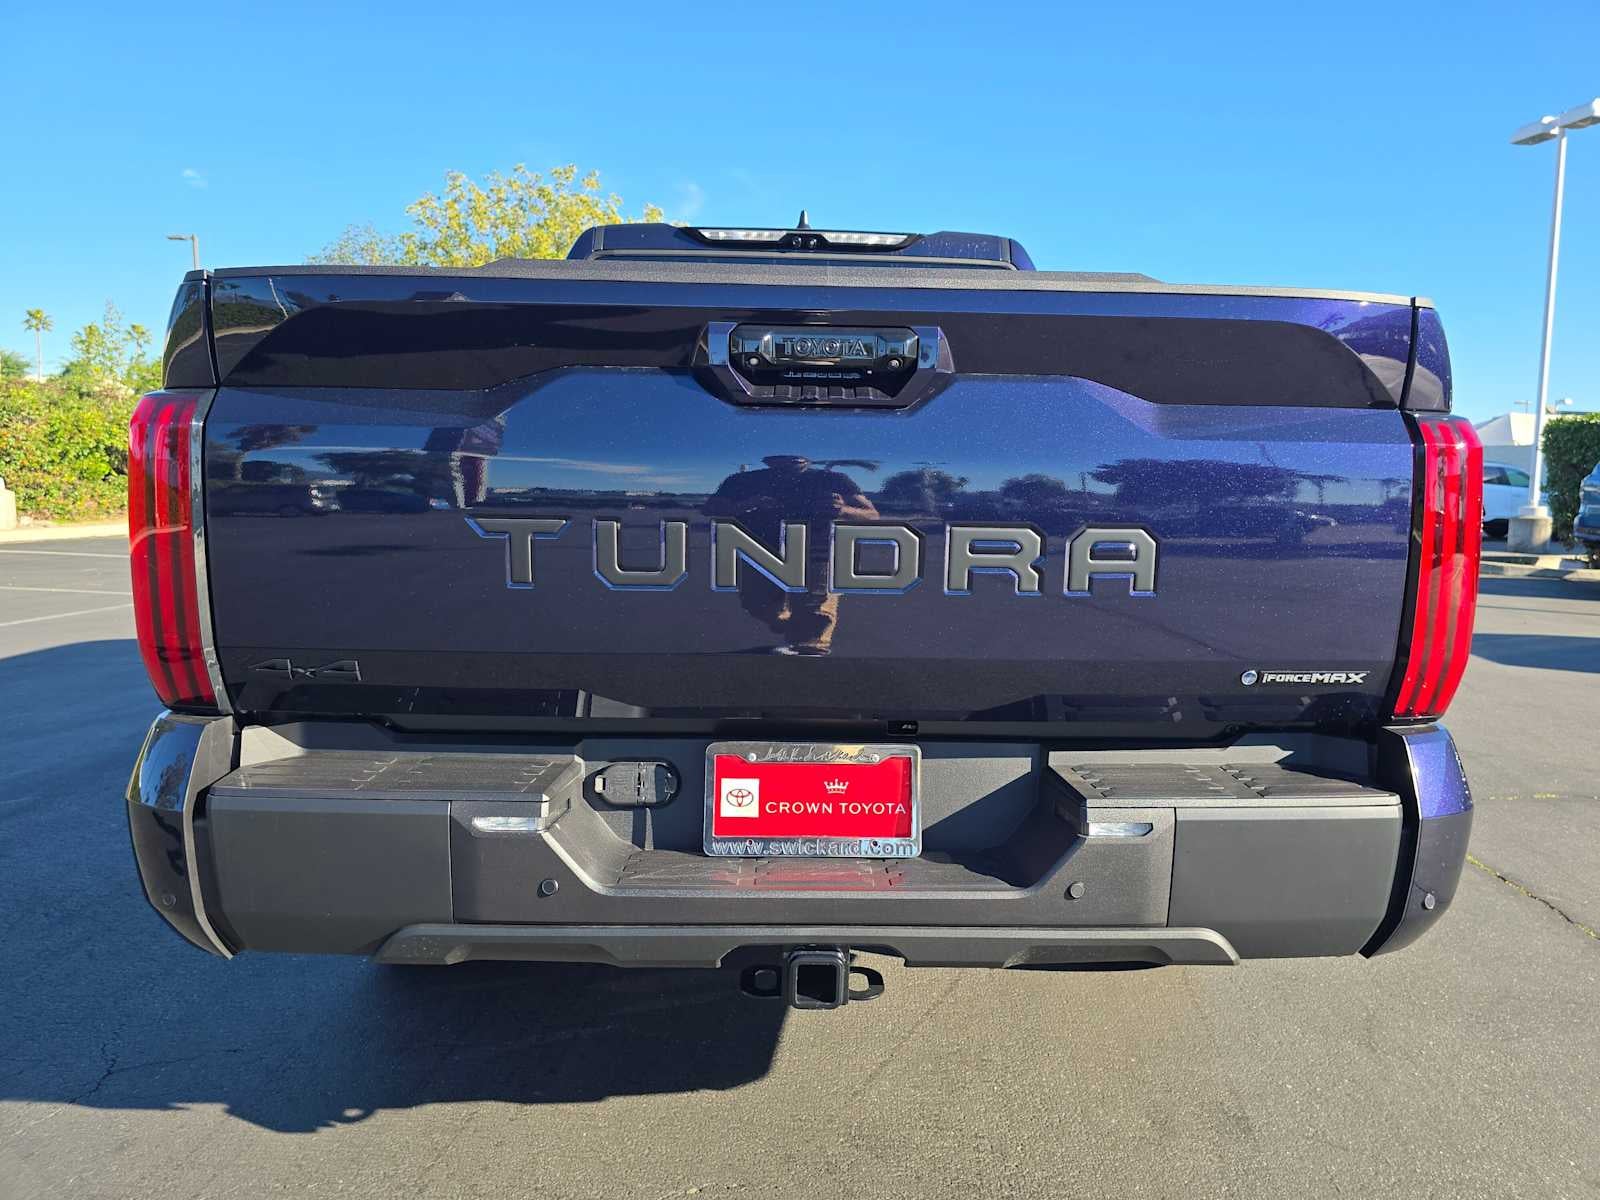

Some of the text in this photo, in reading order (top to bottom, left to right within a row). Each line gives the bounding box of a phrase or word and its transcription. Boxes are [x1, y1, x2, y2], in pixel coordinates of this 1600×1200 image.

[783, 337, 867, 358] TOYOTA
[464, 517, 1160, 596] TUNDRA
[765, 801, 907, 816] CROWN TOYOTA
[711, 839, 914, 856] www.swickard.com
